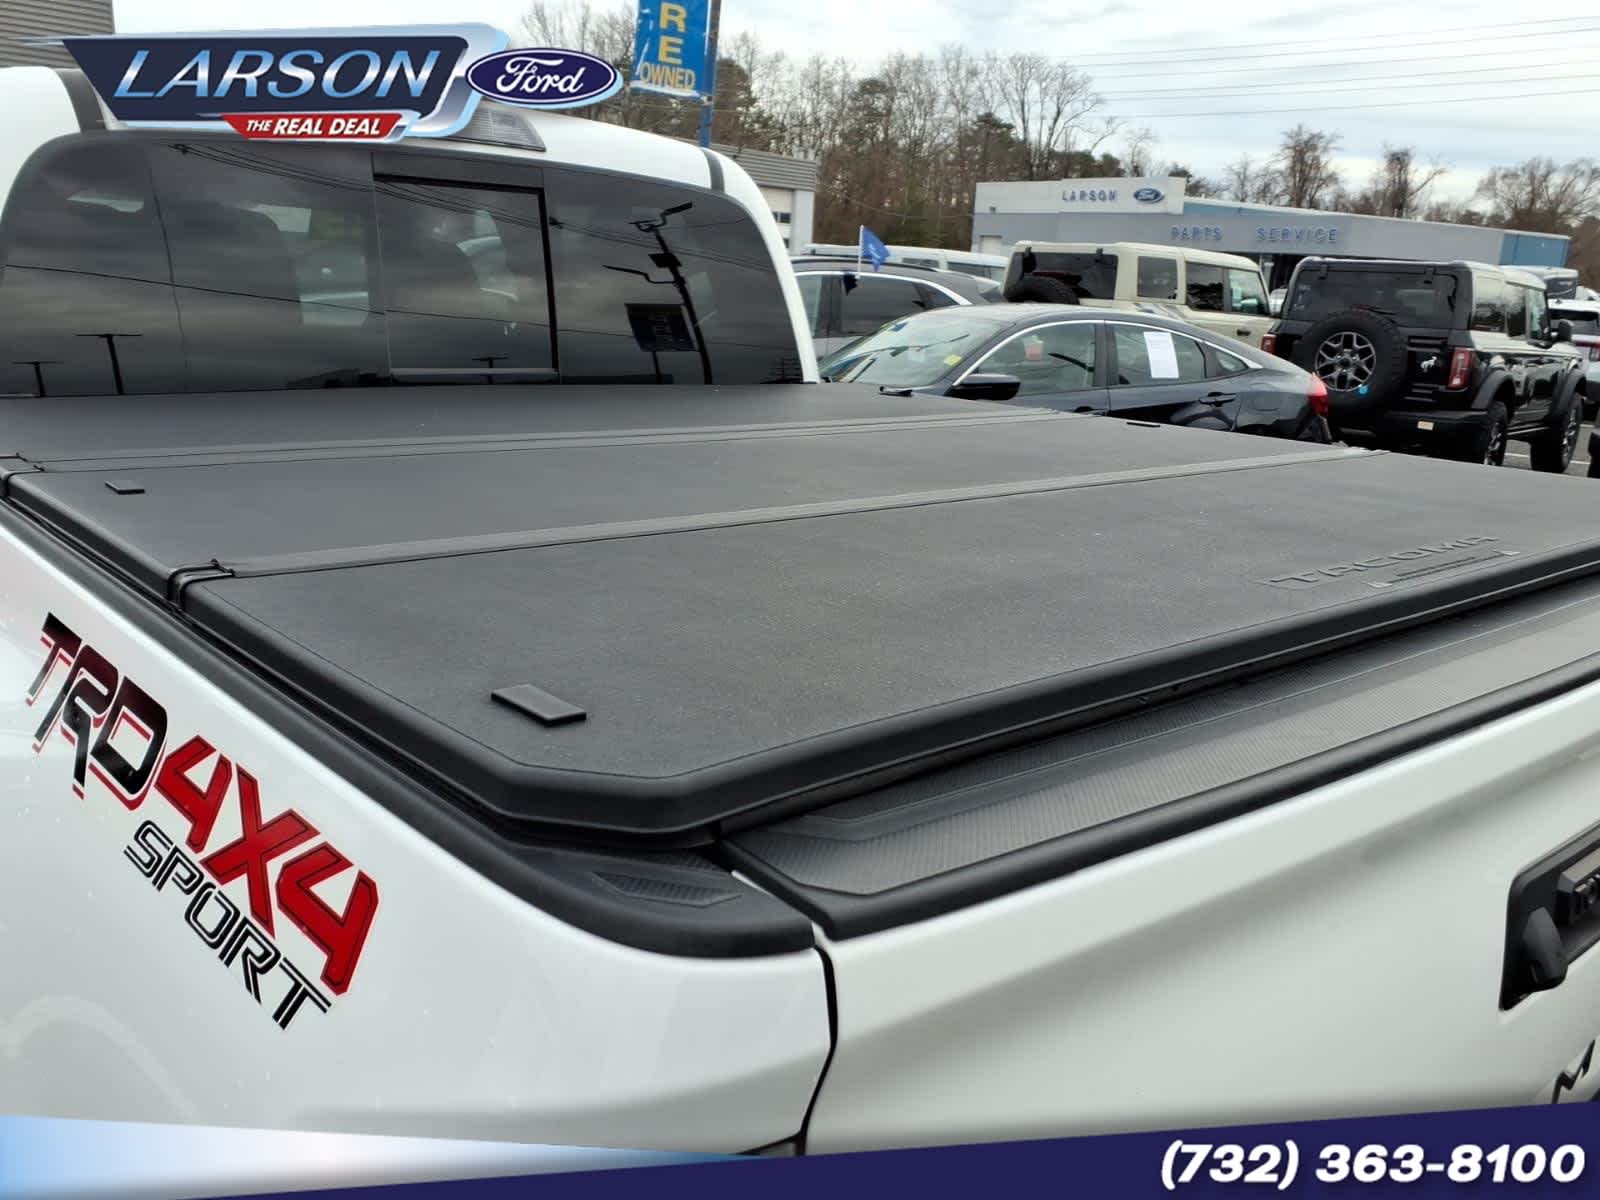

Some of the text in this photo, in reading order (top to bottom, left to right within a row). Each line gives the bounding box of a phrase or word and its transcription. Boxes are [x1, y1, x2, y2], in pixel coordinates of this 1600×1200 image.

[640, 62, 696, 91] OWNED
[1062, 189, 1117, 203] LARSON
[1171, 225, 1338, 244] PARTS SERVICE
[123, 820, 332, 1030] SPORT
